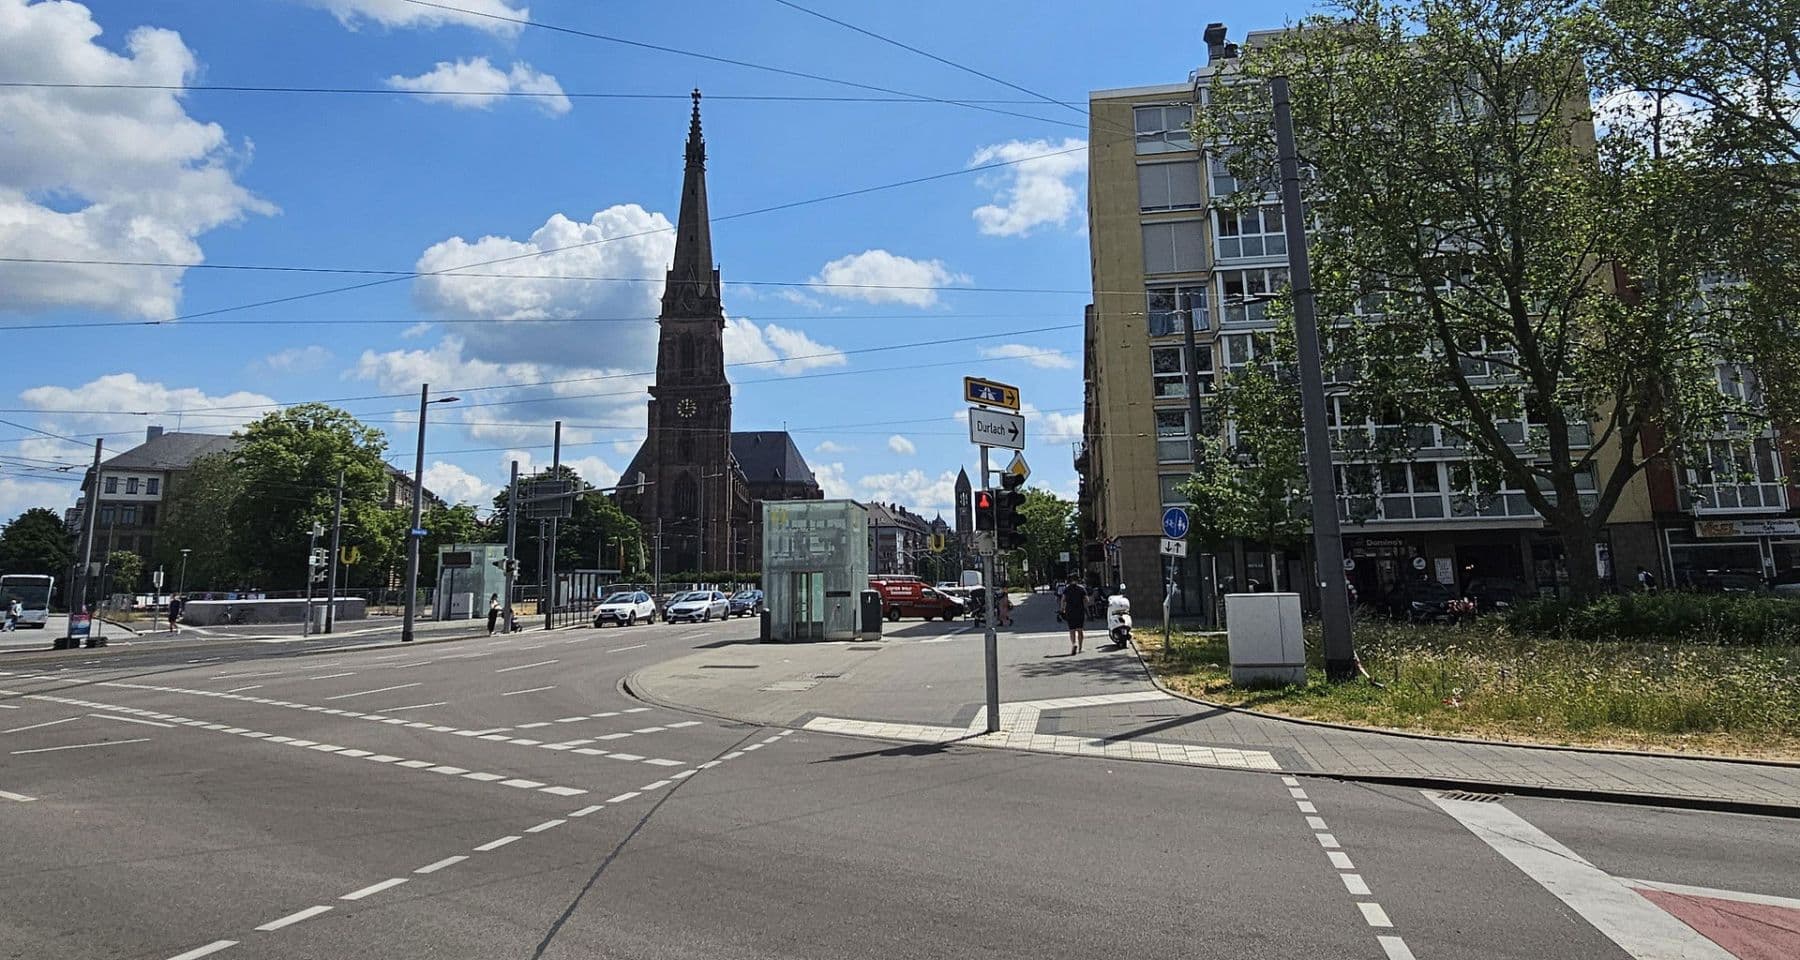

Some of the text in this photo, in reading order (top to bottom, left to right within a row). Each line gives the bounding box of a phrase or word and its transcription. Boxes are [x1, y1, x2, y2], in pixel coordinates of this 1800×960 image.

[977, 420, 1005, 436] Durlach
[930, 533, 945, 552] U
[1366, 539, 1403, 547] Domino's
[341, 545, 358, 565] U
